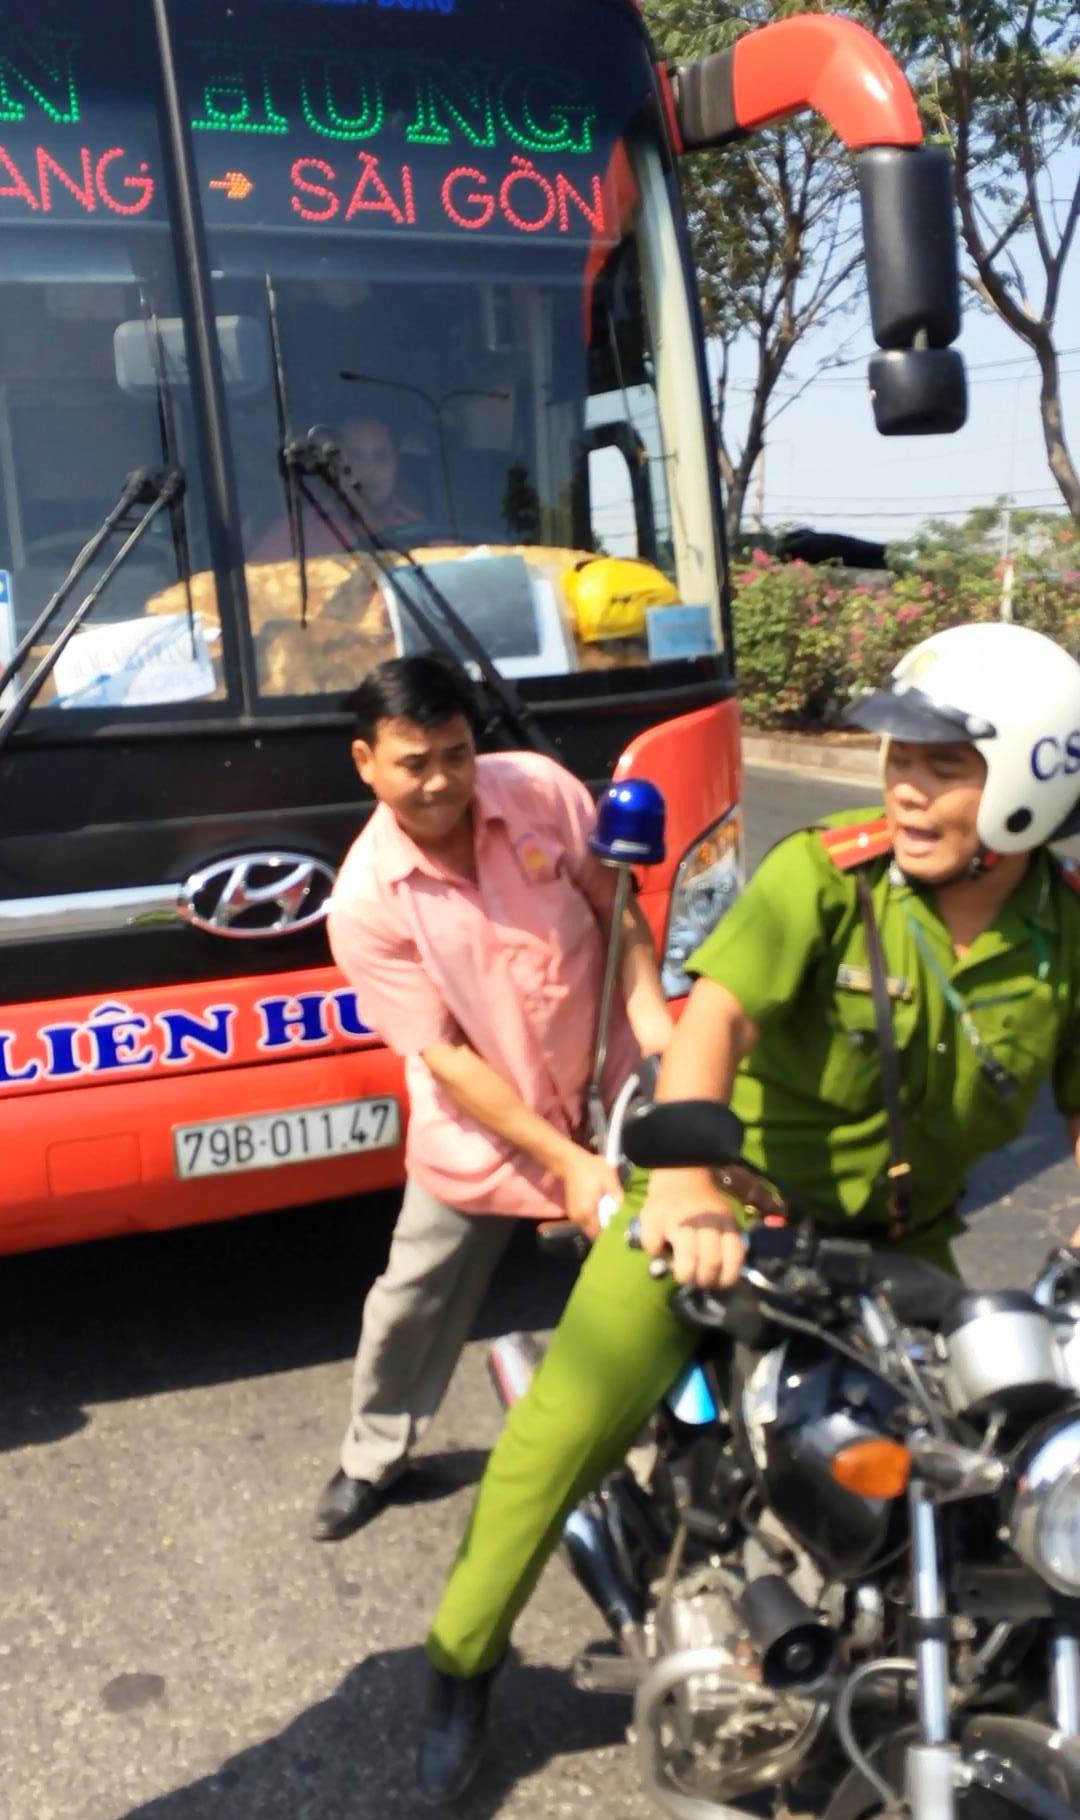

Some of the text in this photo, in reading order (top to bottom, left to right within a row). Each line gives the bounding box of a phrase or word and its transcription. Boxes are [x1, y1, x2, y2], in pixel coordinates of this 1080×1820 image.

[290, 151, 416, 223] SÀI
[441, 154, 605, 233] GÒN
[0, 1001, 237, 1084] LIÊN
